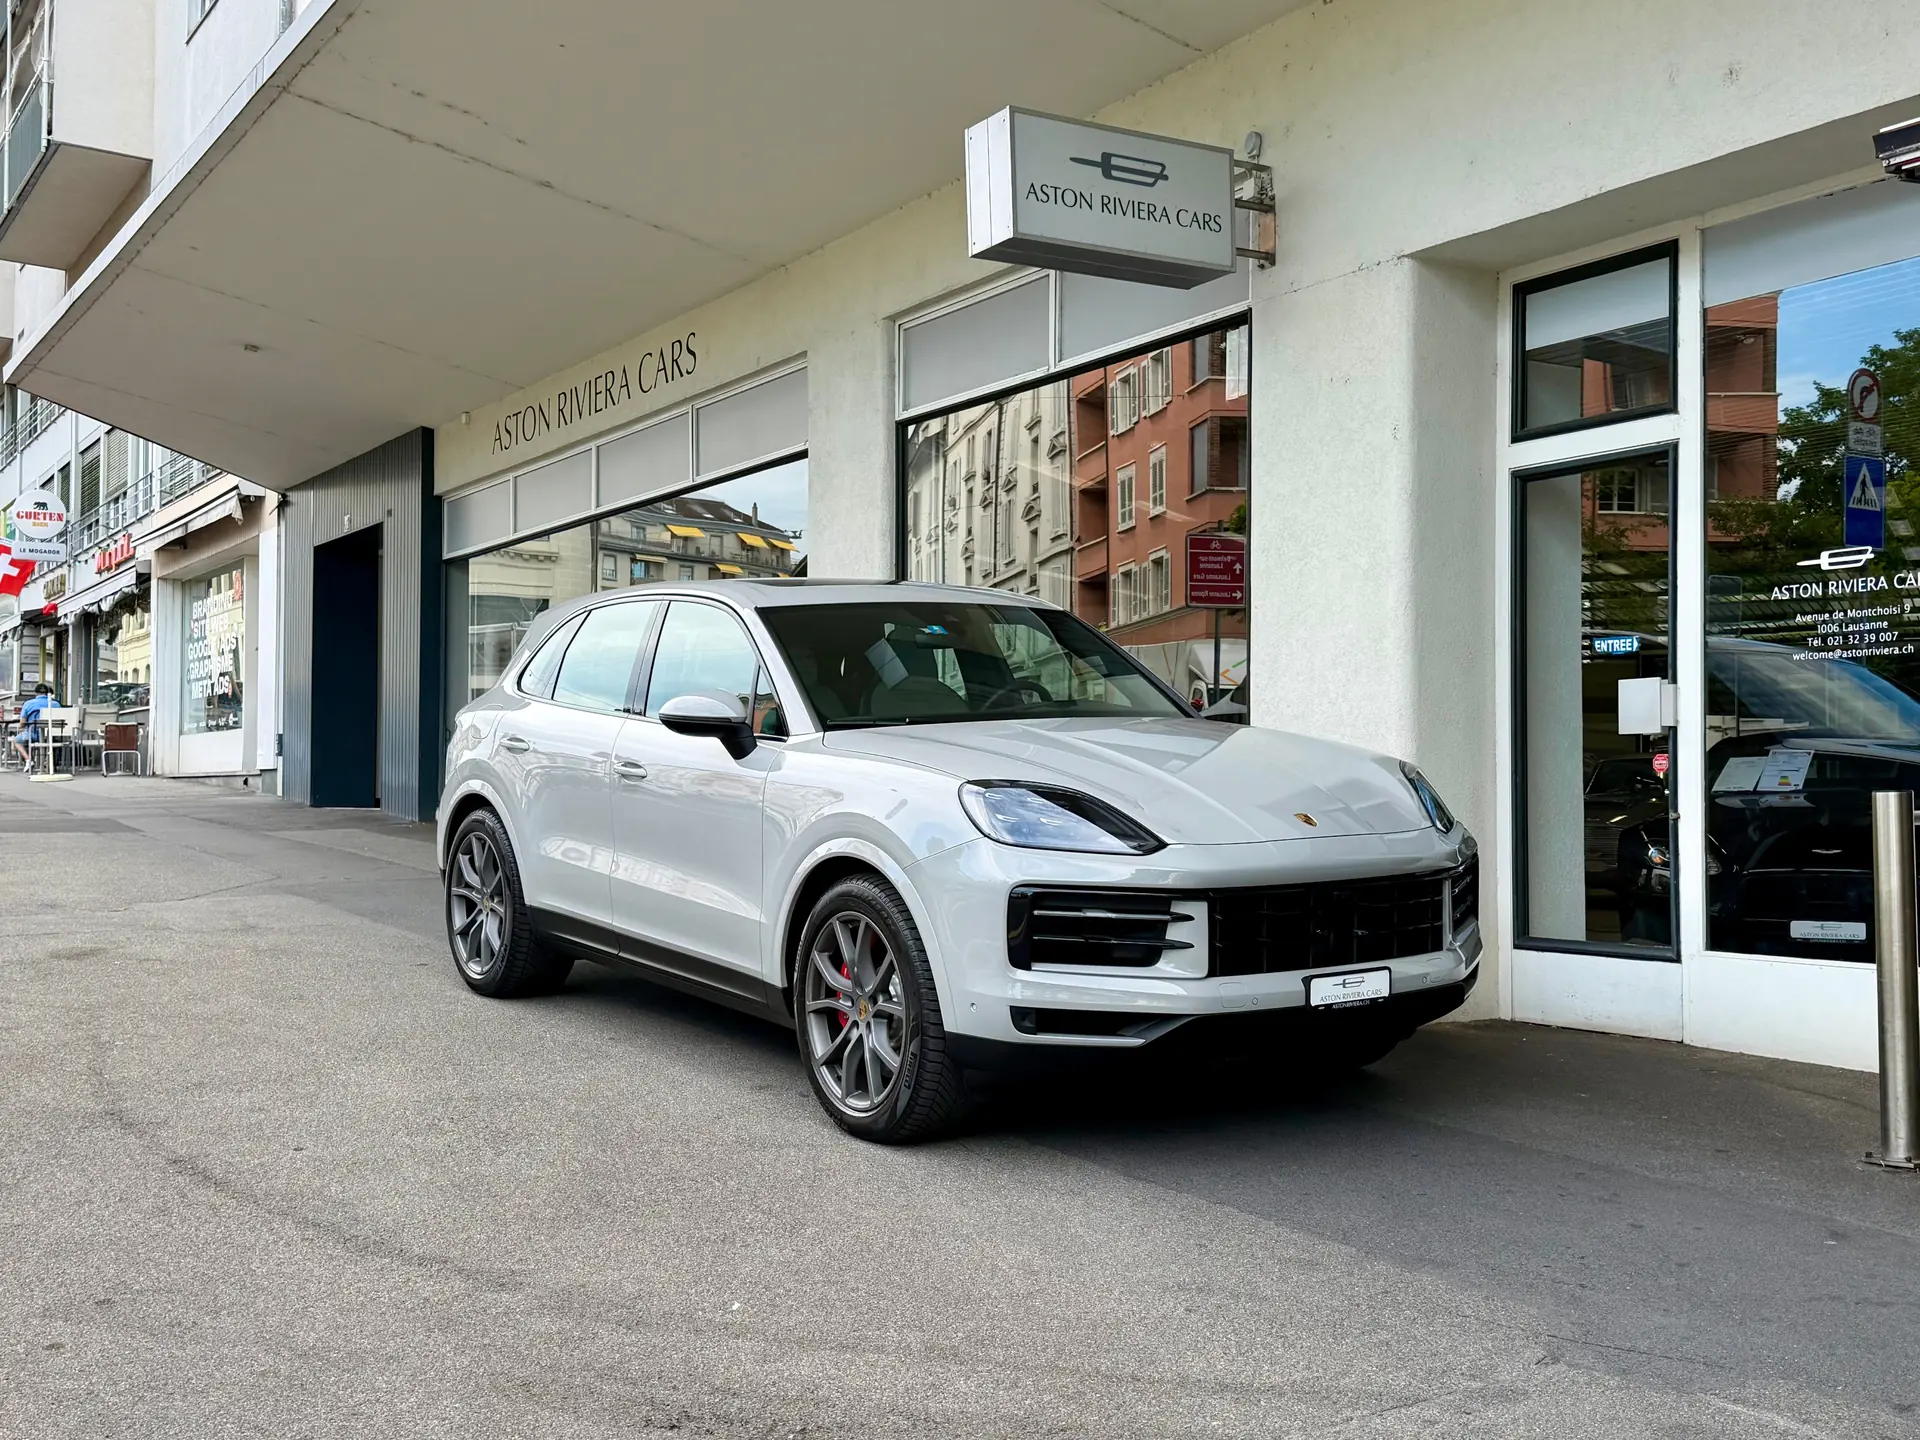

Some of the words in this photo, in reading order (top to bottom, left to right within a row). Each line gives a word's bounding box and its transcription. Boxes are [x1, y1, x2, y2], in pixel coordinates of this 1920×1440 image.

[1025, 182, 1093, 211] ASTON
[1101, 194, 1171, 225] RIVIERA
[1176, 208, 1222, 233] CARS
[492, 397, 550, 455] ASTON
[557, 364, 631, 429] RIVIERA
[638, 332, 697, 394] CARS
[16, 510, 64, 522] GURTEN
[1771, 582, 1823, 600] ASTON
[1828, 576, 1888, 596] RIVIERA
[1795, 613, 1829, 623] Avenue
[1832, 609, 1845, 620] de
[1847, 604, 1900, 618] Montchoisi
[1904, 603, 1911, 614] 9
[1817, 623, 1840, 634] 1006
[1842, 620, 1889, 632] Lausanne
[220, 631, 237, 653] ADS
[1594, 638, 1633, 653] ENTREE
[1807, 637, 1824, 647] Tél.
[1827, 636, 1843, 646] 021
[1847, 635, 1860, 645] 32
[1863, 633, 1876, 643] 39
[1879, 631, 1898, 642] 007
[1792, 643, 1914, 661] welcome@astonriviera.ch
[191, 679, 212, 700] META
[213, 675, 230, 696] ADS
[1320, 994, 1342, 1003] ASTON
[1342, 991, 1365, 1000] RIVIERA
[1366, 988, 1383, 996] CARS
